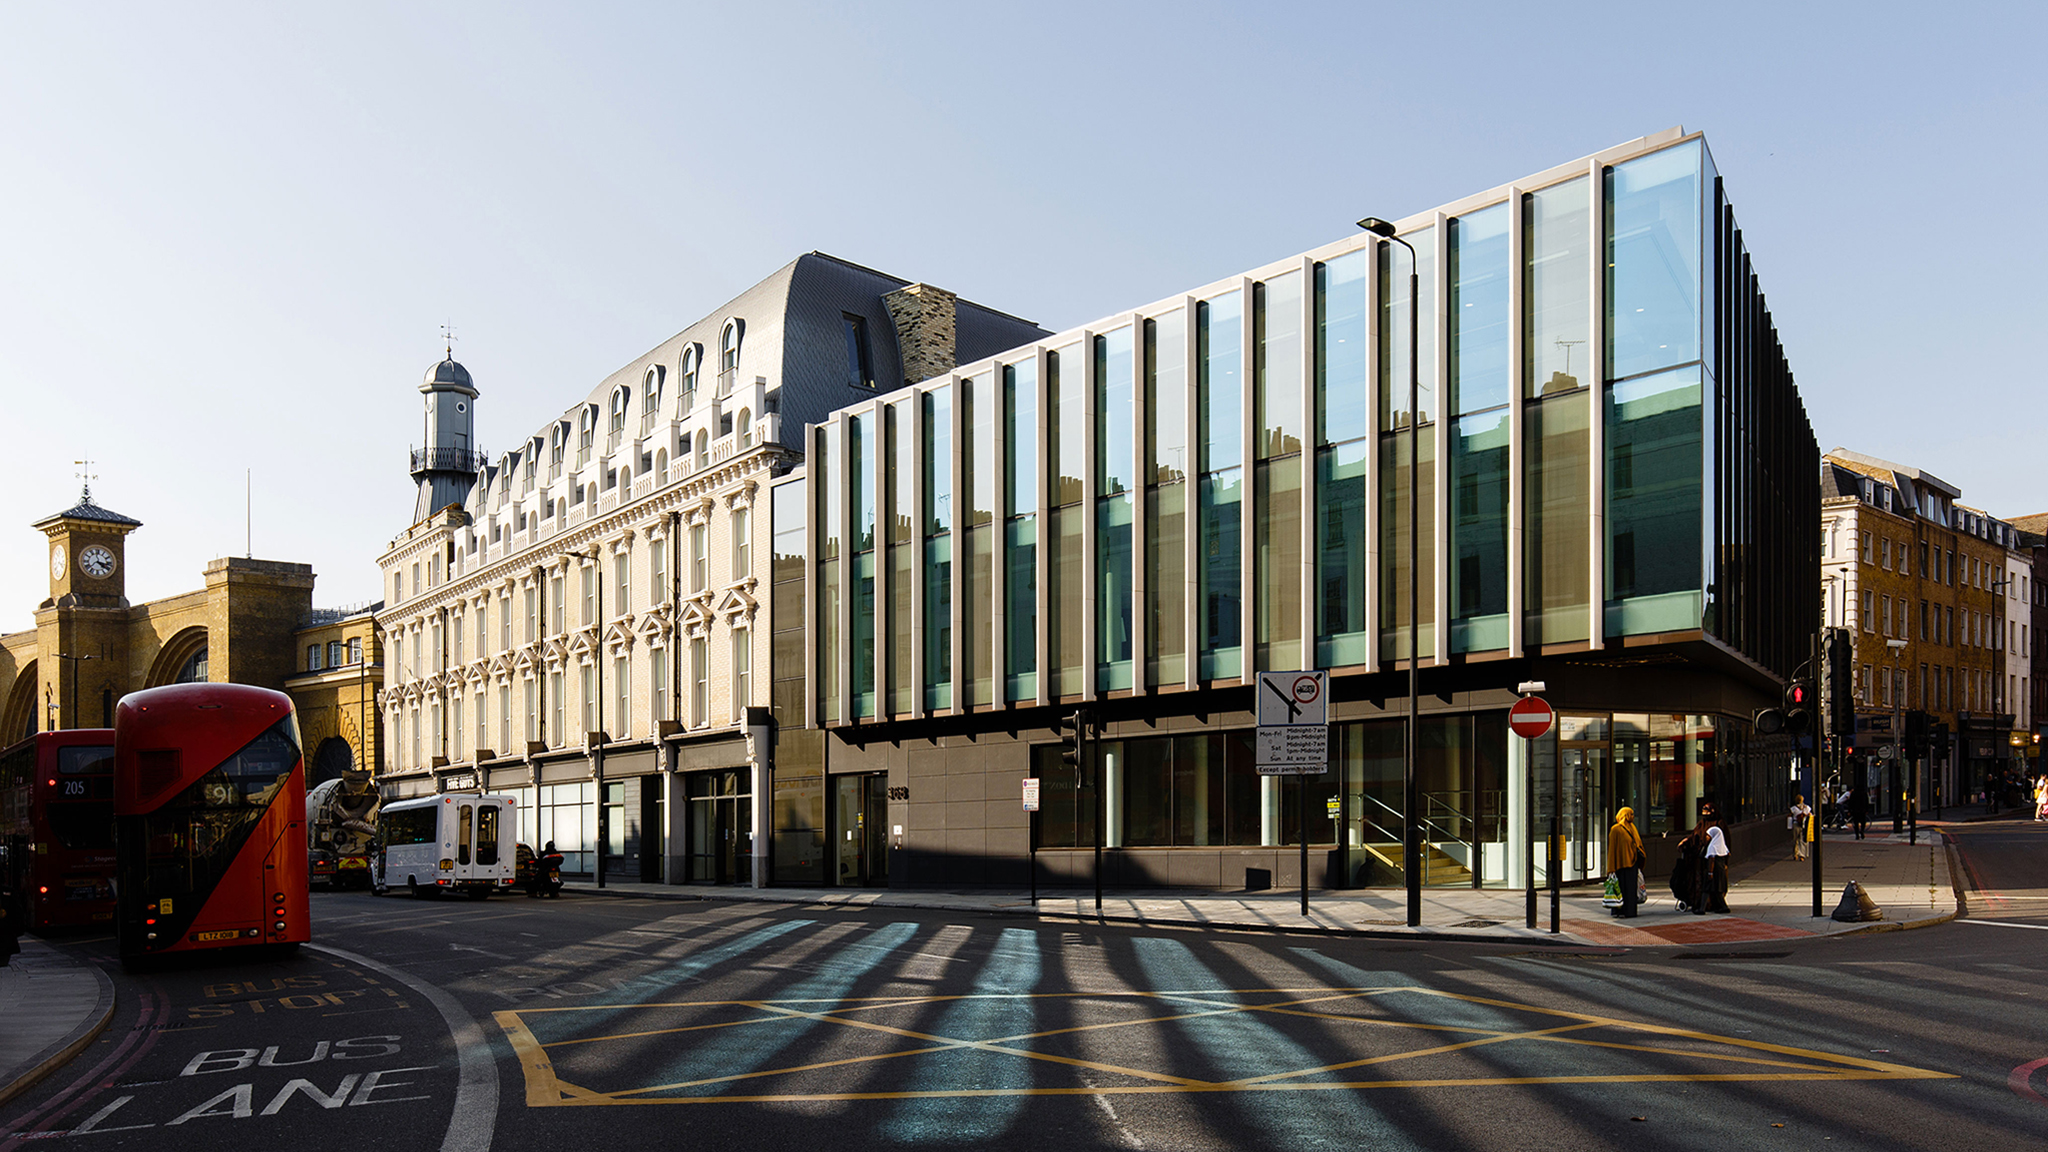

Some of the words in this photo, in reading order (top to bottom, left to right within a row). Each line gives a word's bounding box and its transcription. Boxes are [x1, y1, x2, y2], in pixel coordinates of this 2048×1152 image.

[64, 780, 85, 795] 205
[446, 777, 459, 790] FIVE
[459, 775, 475, 789] GUYS
[213, 785, 233, 806] 91
[203, 975, 328, 998] BUS
[187, 988, 366, 1019] STOP
[179, 1034, 402, 1077] BUS
[66, 1065, 439, 1137] LANE
